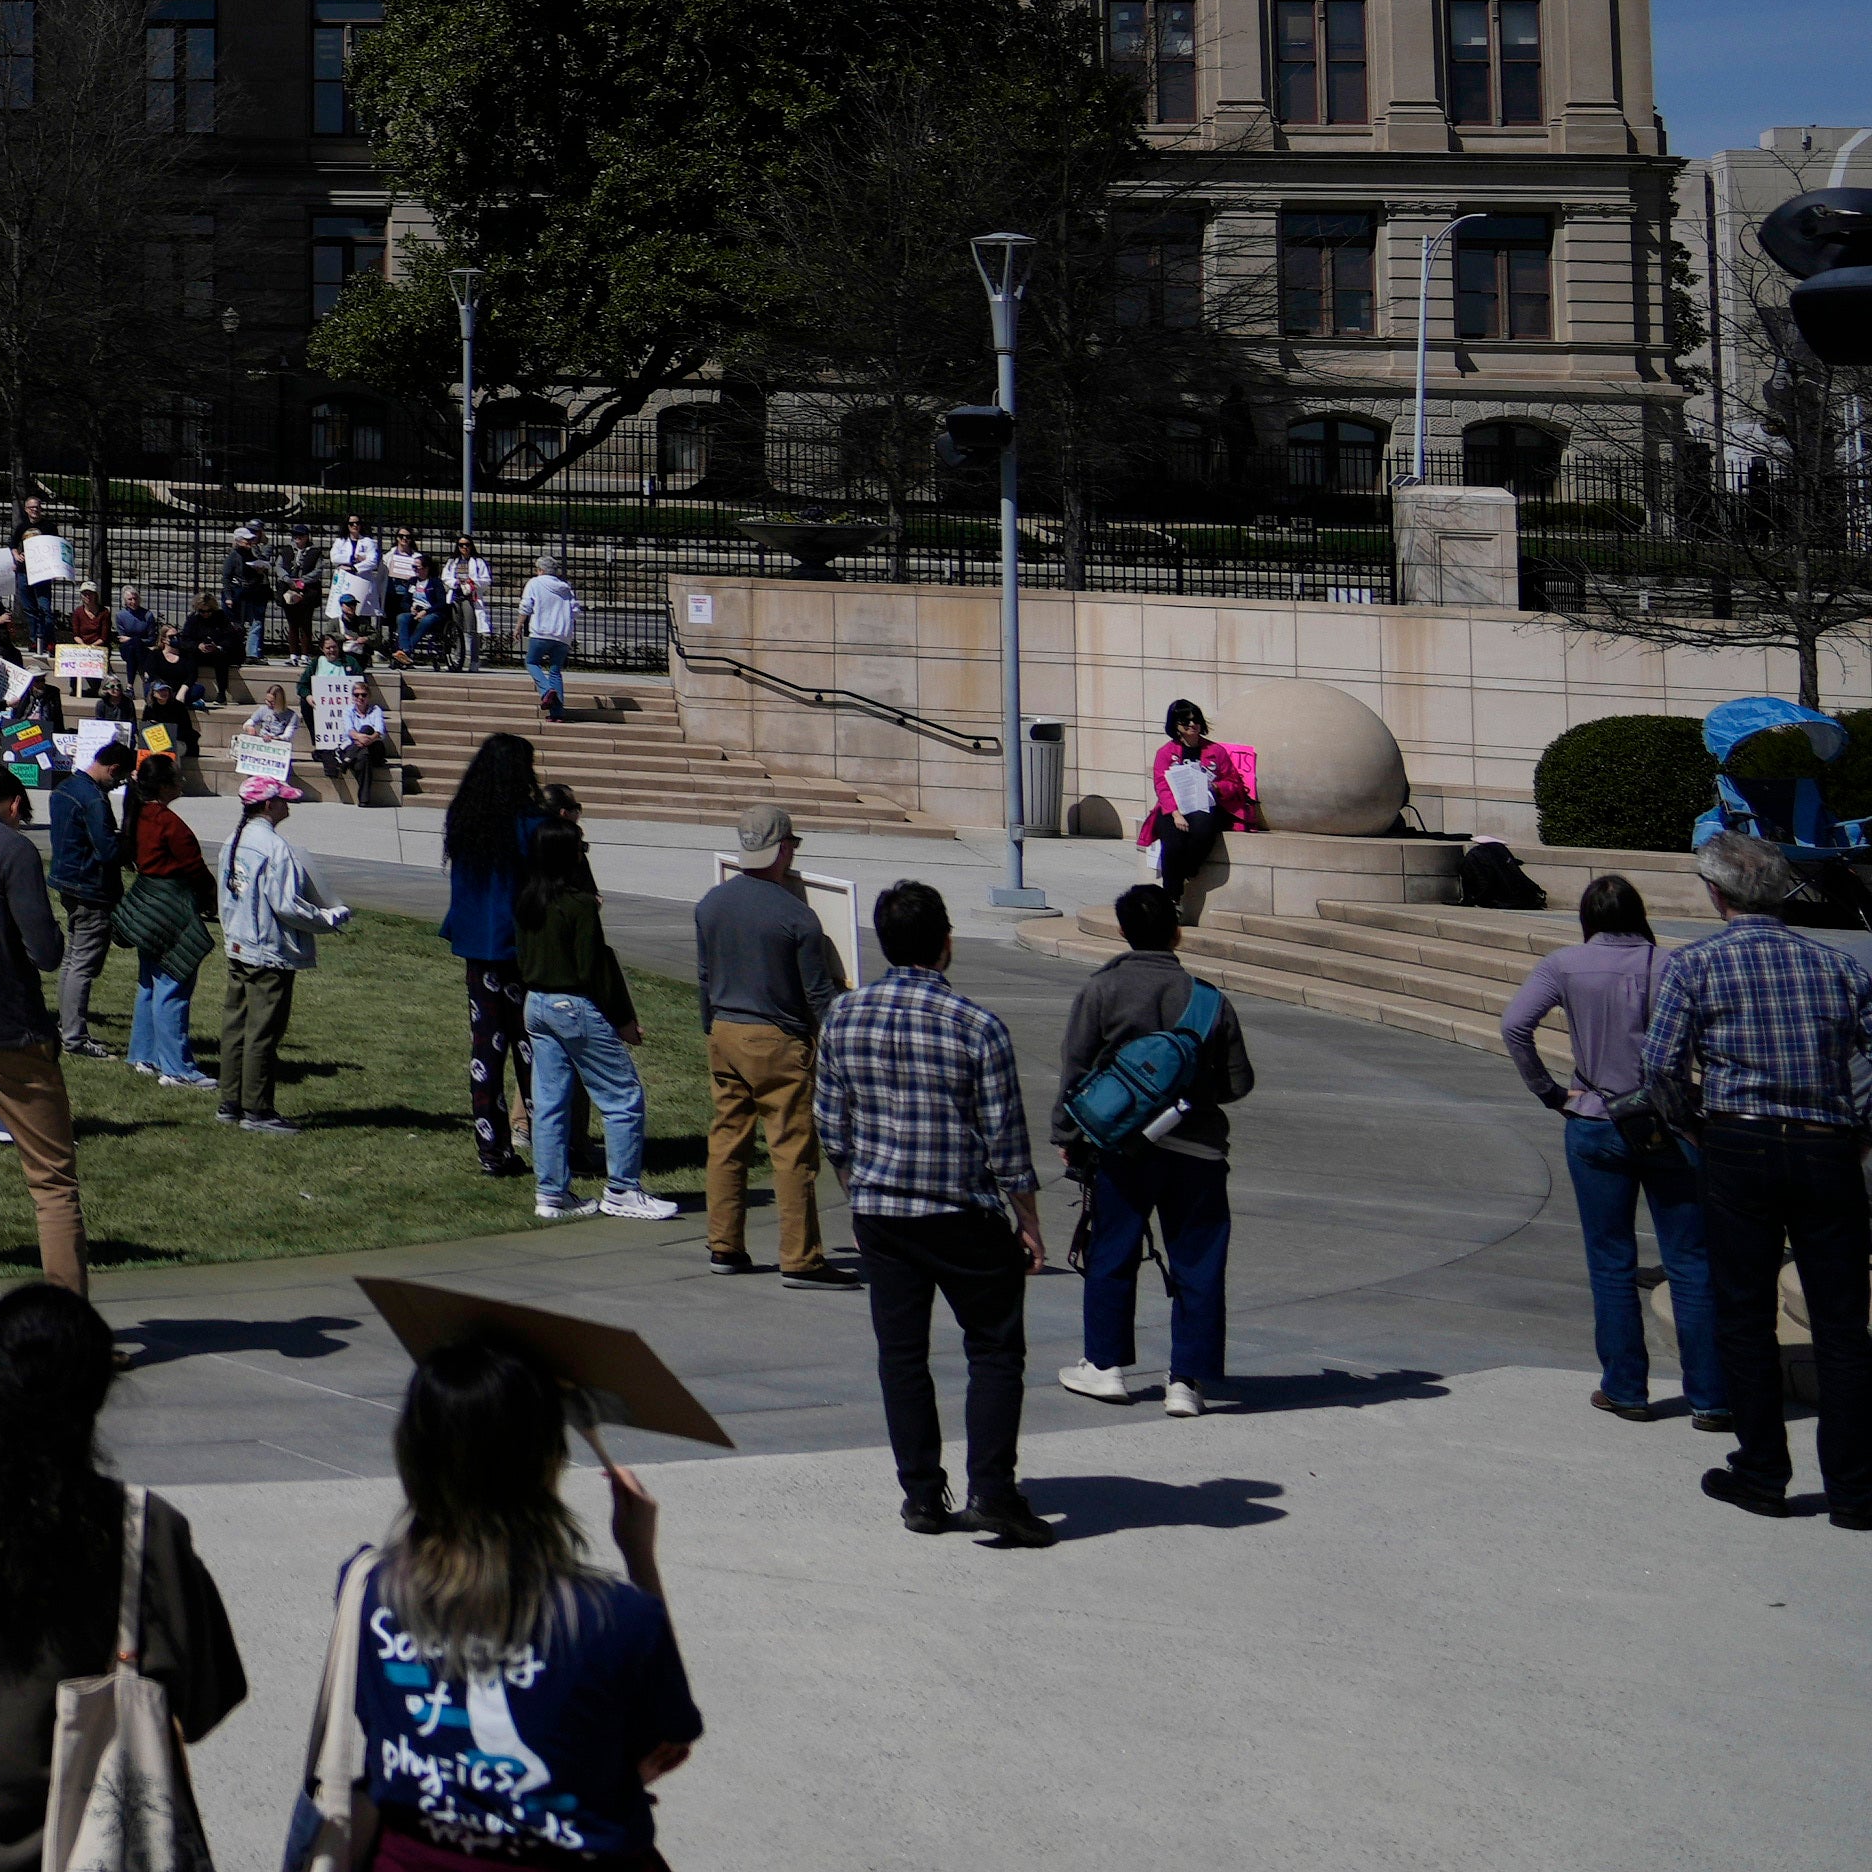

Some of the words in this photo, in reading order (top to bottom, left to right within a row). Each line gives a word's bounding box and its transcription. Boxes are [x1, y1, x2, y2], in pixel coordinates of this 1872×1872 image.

[328, 684, 349, 693] THE
[321, 696, 349, 705] FACT
[329, 709, 343, 718] AR
[325, 721, 339, 730] WI
[56, 734, 78, 744] SCIE
[315, 734, 344, 743] SCIE
[241, 742, 288, 756] EFFICIENCY
[240, 754, 286, 769] OPTIMIZATION
[404, 1681, 453, 1737] of
